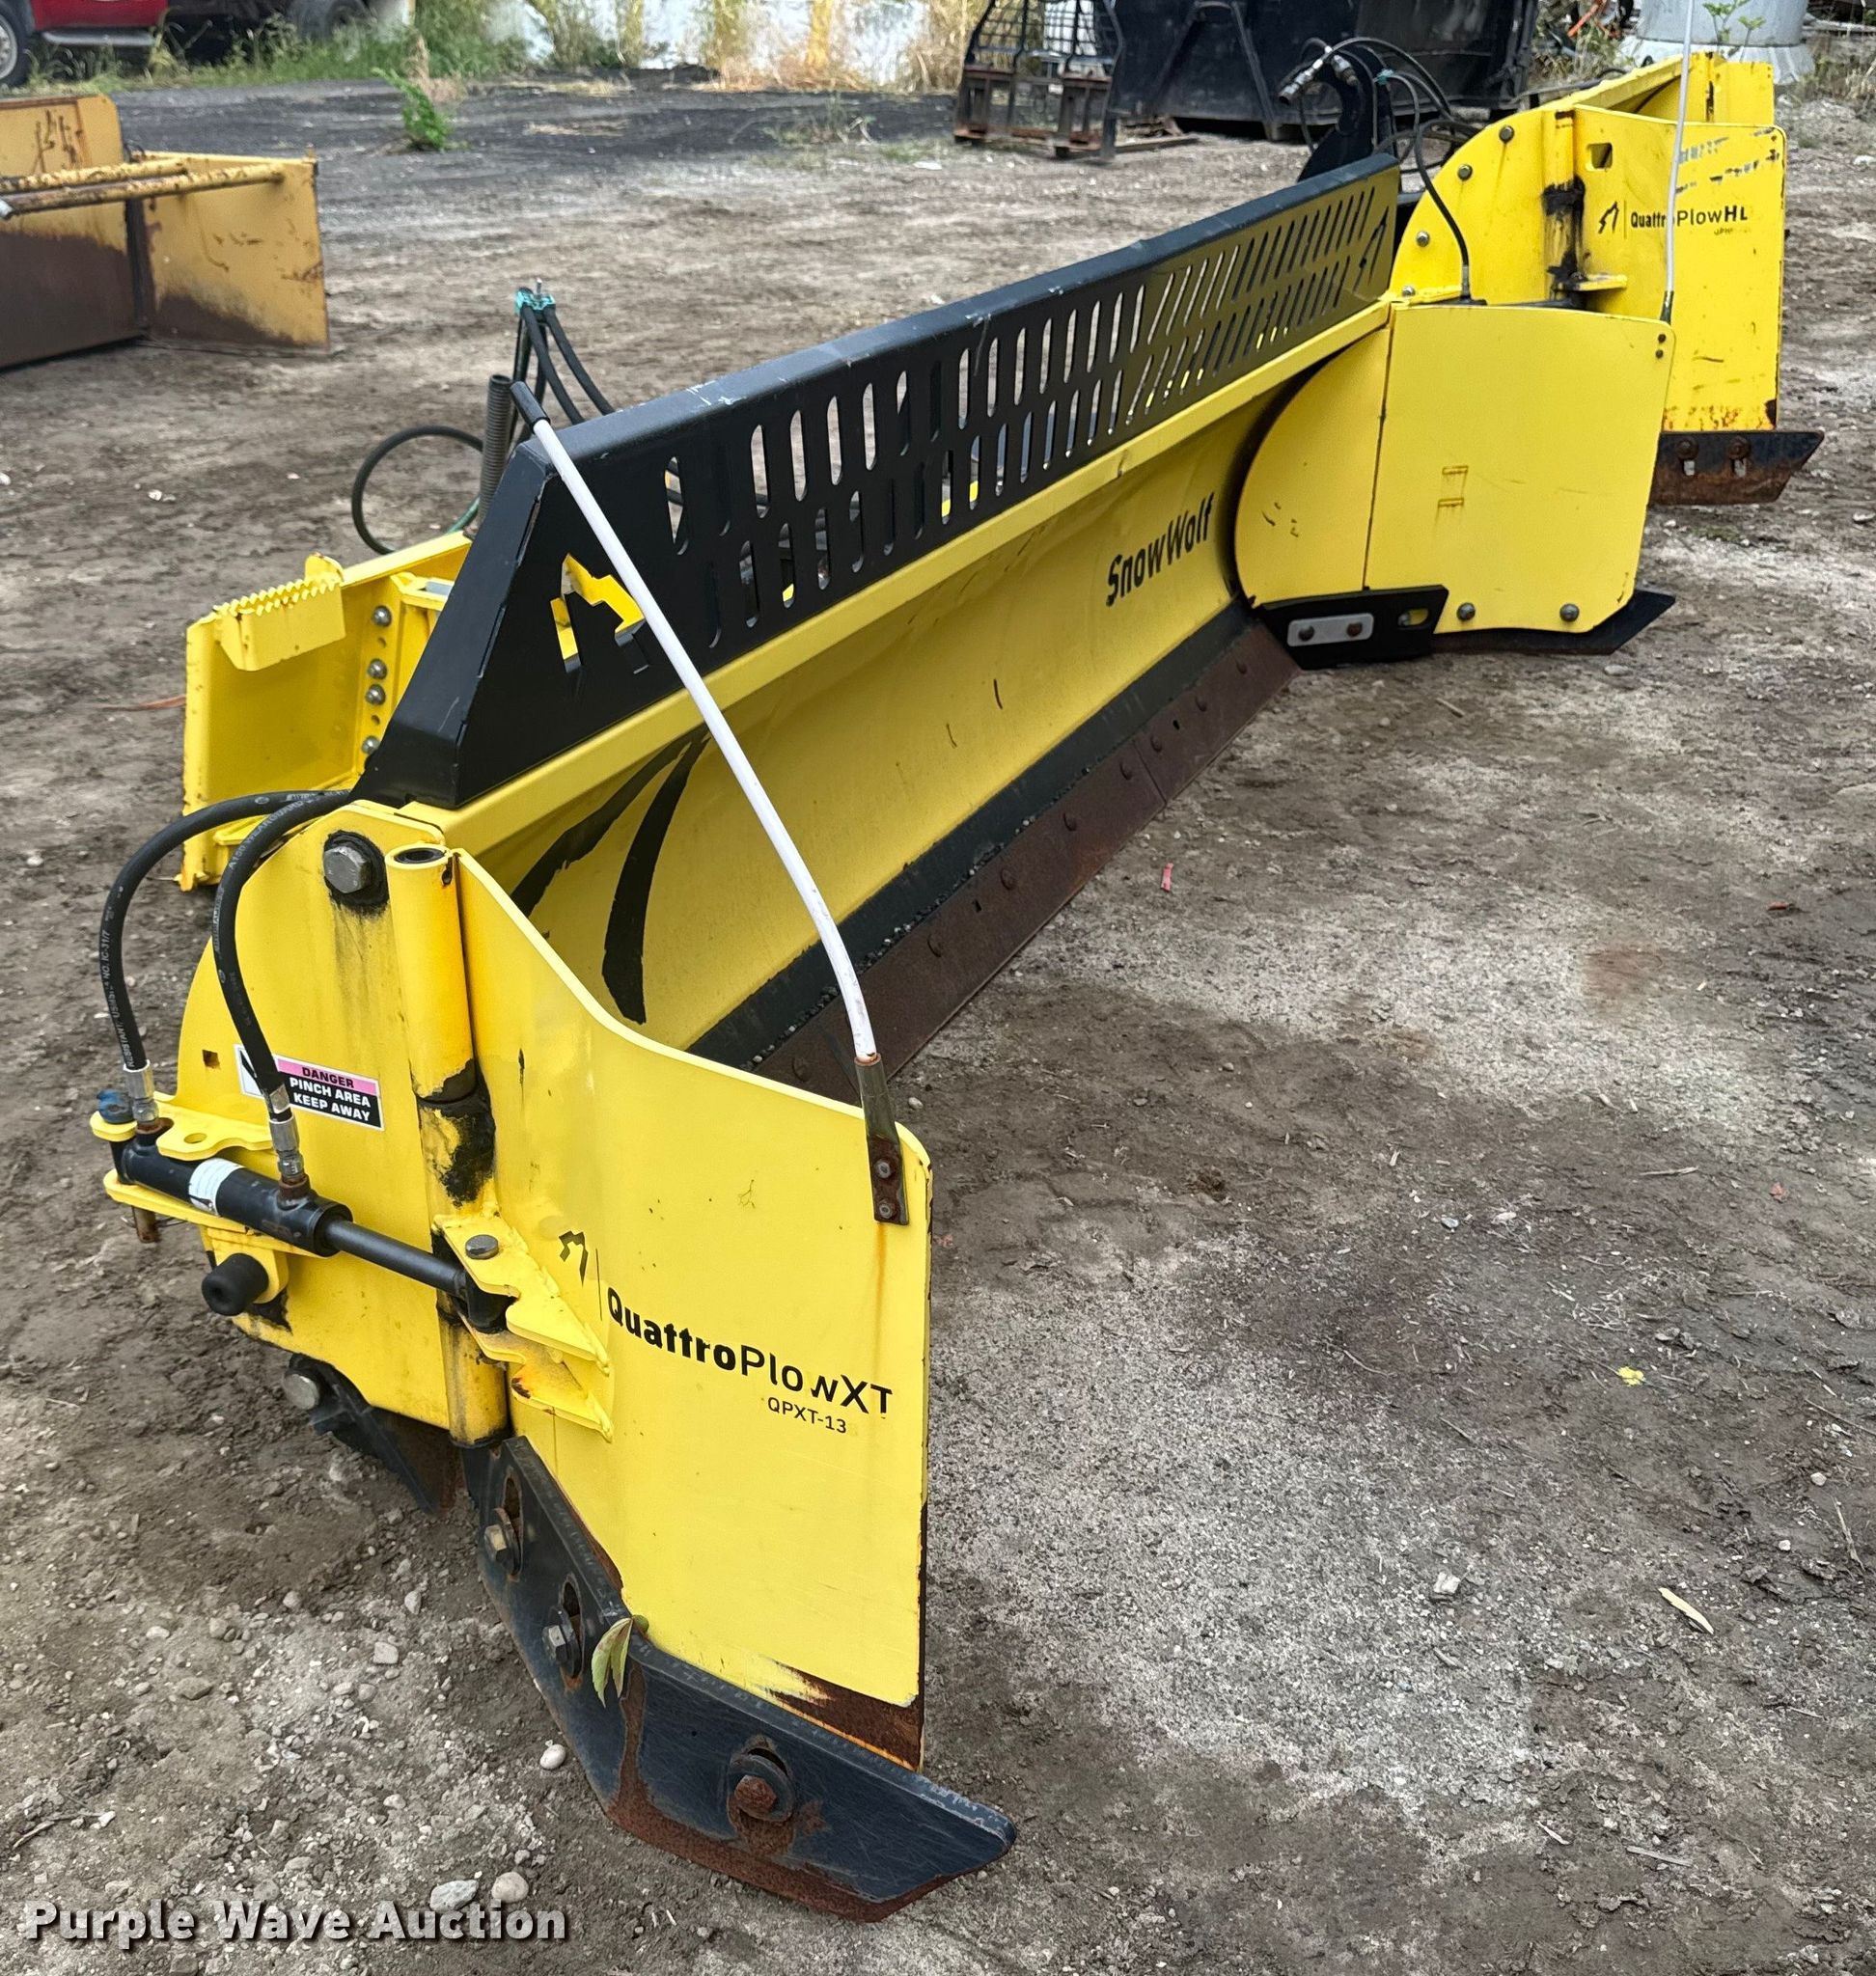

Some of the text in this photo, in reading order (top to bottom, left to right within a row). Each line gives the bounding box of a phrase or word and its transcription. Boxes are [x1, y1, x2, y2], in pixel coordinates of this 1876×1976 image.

[1630, 205, 1749, 229] QuattrPlowHL
[1105, 491, 1215, 608] SnowWolf
[290, 1077, 372, 1109] PINCH AREA
[301, 1066, 355, 1089] DANGER
[292, 1092, 371, 1122] KEEP AWAY
[606, 1286, 894, 1416] QuattroPlowXT
[766, 1396, 847, 1435] QPXT-13
